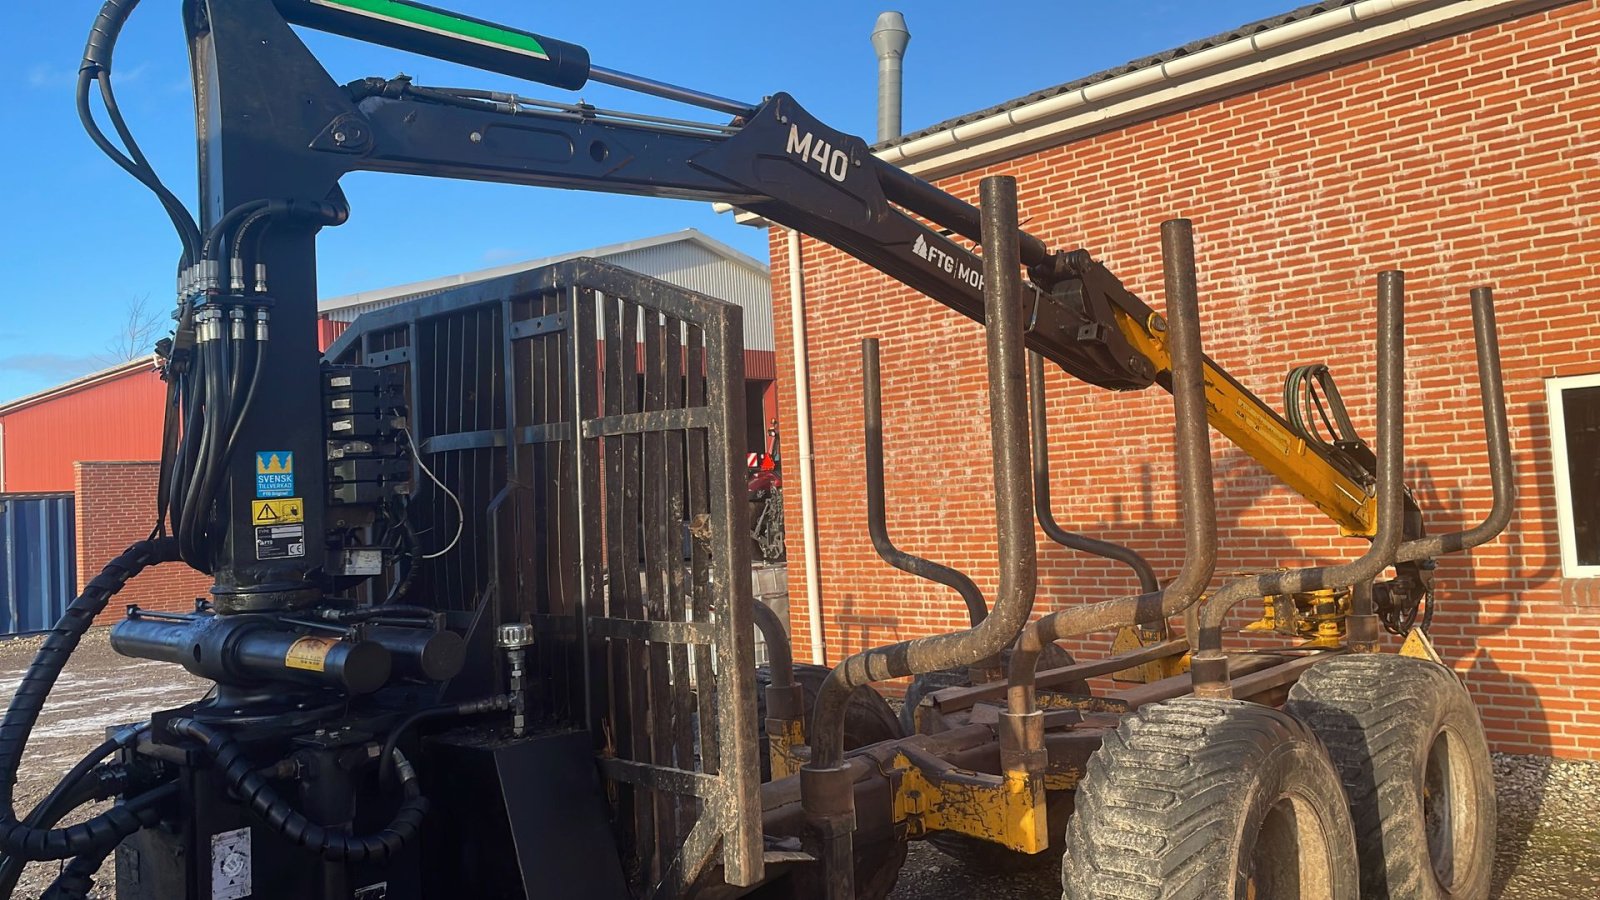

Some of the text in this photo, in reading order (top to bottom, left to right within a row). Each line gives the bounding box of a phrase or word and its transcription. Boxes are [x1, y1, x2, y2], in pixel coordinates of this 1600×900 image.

[786, 123, 848, 182] M40
[927, 246, 954, 273] FTG
[258, 474, 292, 483] SVENSK
[289, 543, 302, 554] CE
